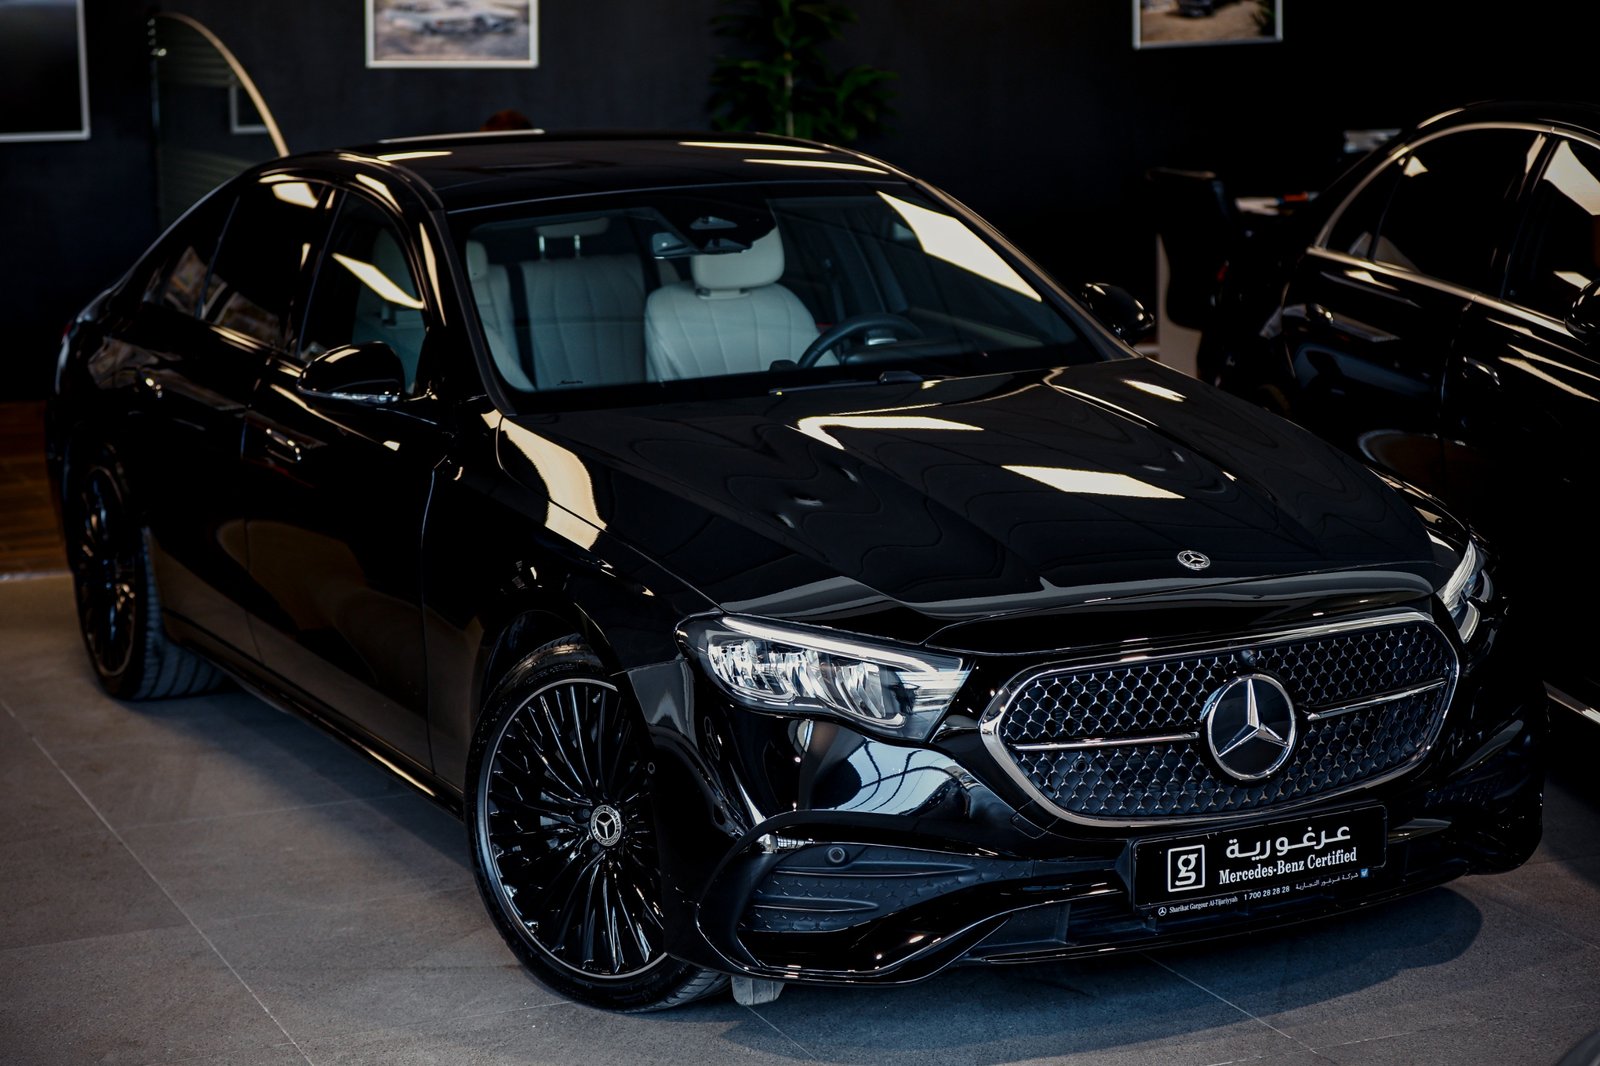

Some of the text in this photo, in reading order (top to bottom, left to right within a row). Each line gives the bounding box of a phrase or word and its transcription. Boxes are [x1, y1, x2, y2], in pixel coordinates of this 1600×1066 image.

[1174, 853, 1199, 886] g
[1219, 847, 1358, 885] Mercedes-Benz Certified
[1249, 891, 1261, 900] 700
[1262, 889, 1271, 897] 28
[1272, 887, 1280, 895] 28
[1281, 885, 1290, 893] 28
[1169, 904, 1189, 913] Sharikat
